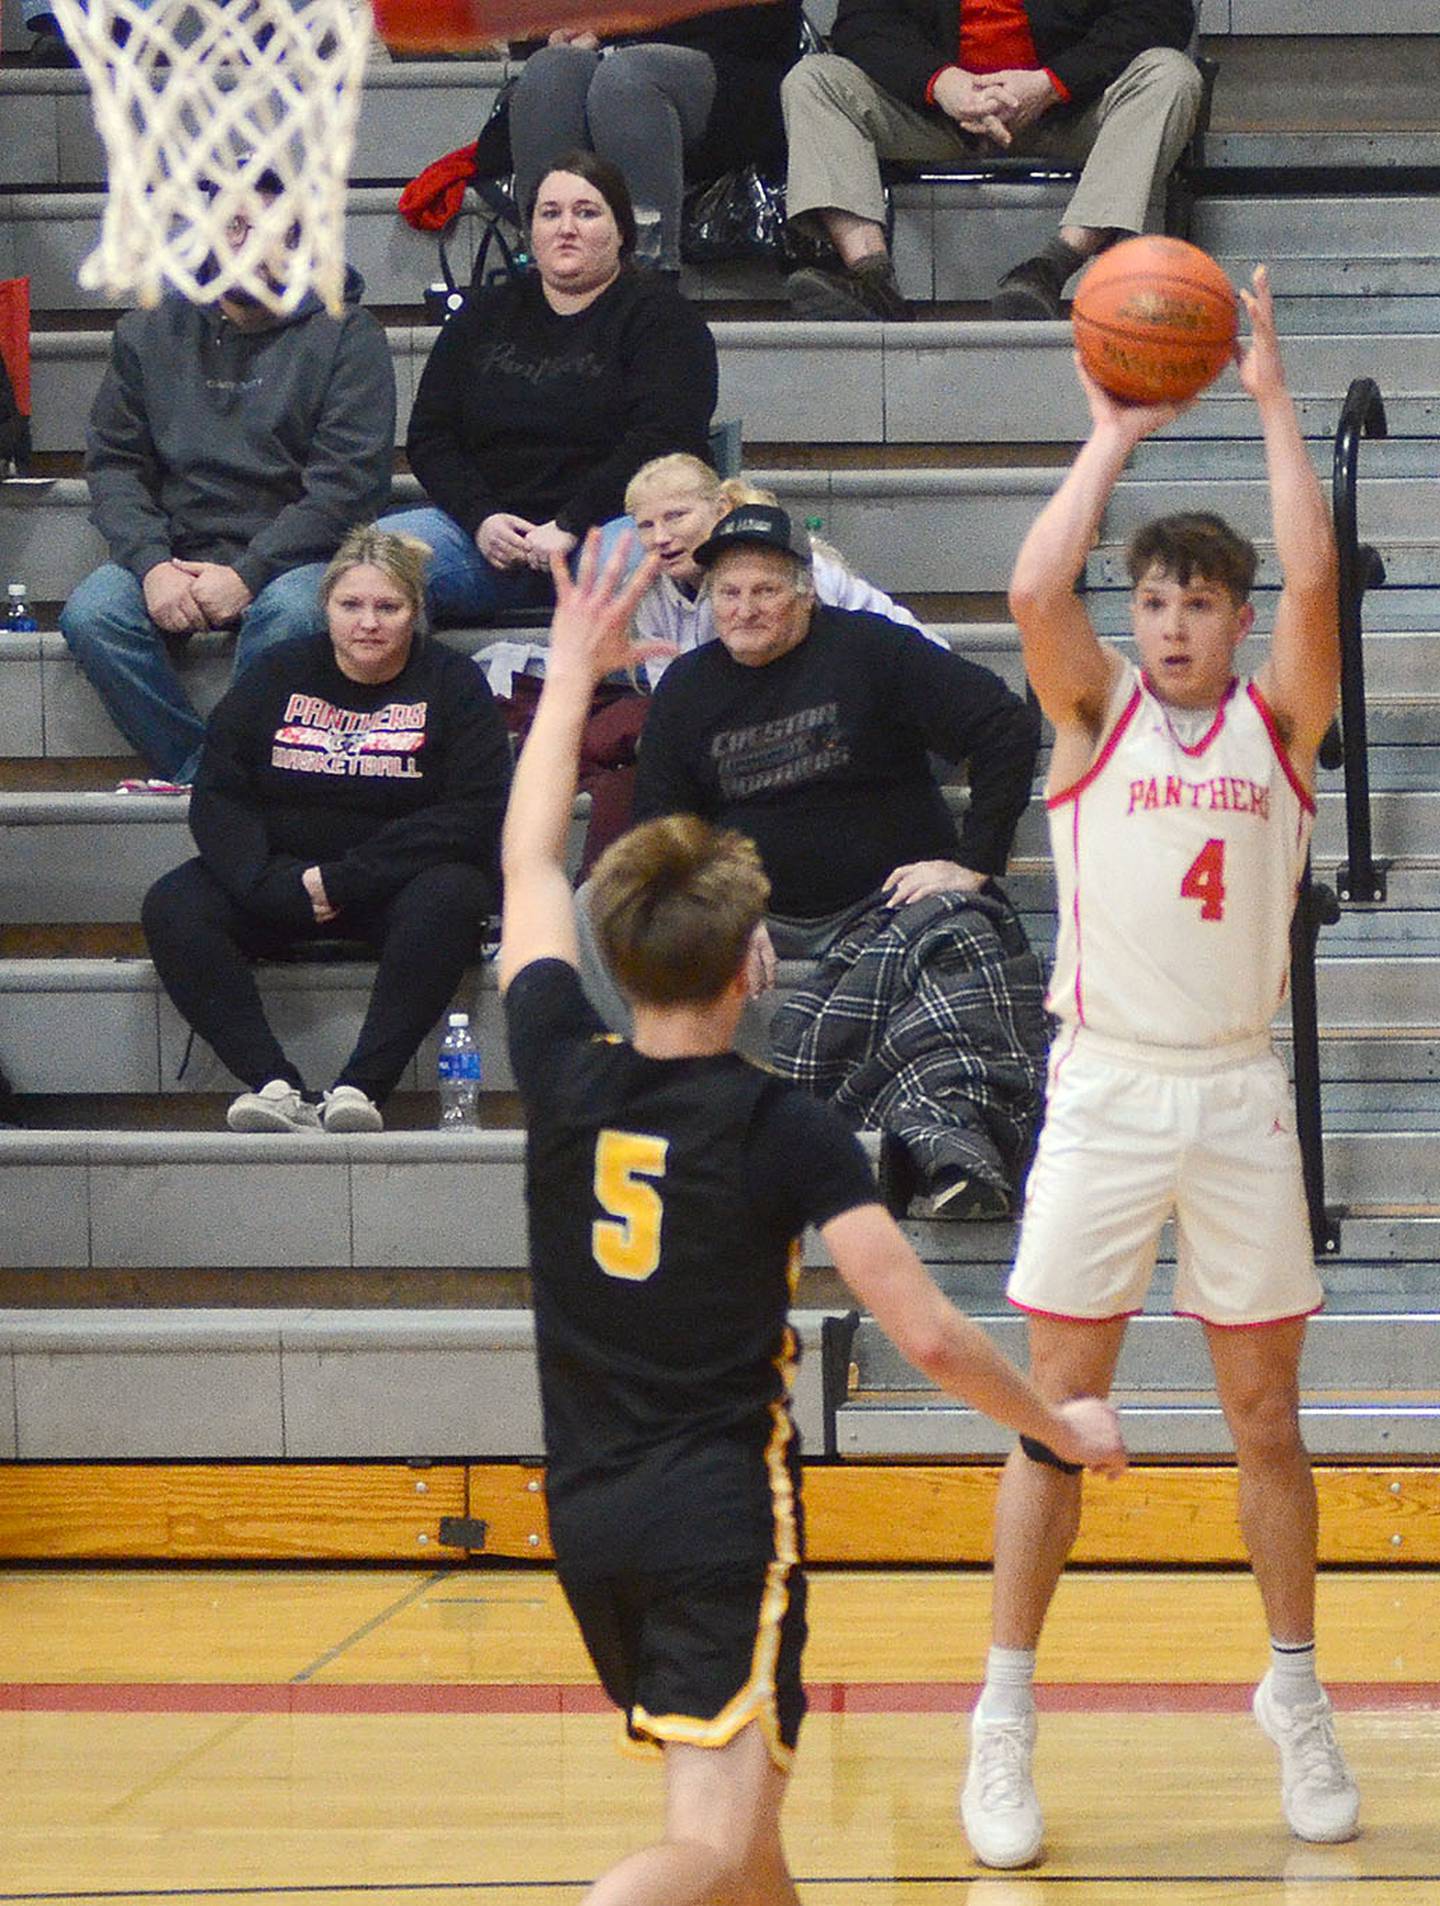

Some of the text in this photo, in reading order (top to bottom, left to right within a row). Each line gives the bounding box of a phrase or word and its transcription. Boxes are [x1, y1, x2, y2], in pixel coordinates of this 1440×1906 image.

[284, 693, 427, 731] PANTHERS
[271, 746, 423, 778] BASKETBALL
[1180, 838, 1225, 920] 4
[592, 1129, 669, 1281] 5
